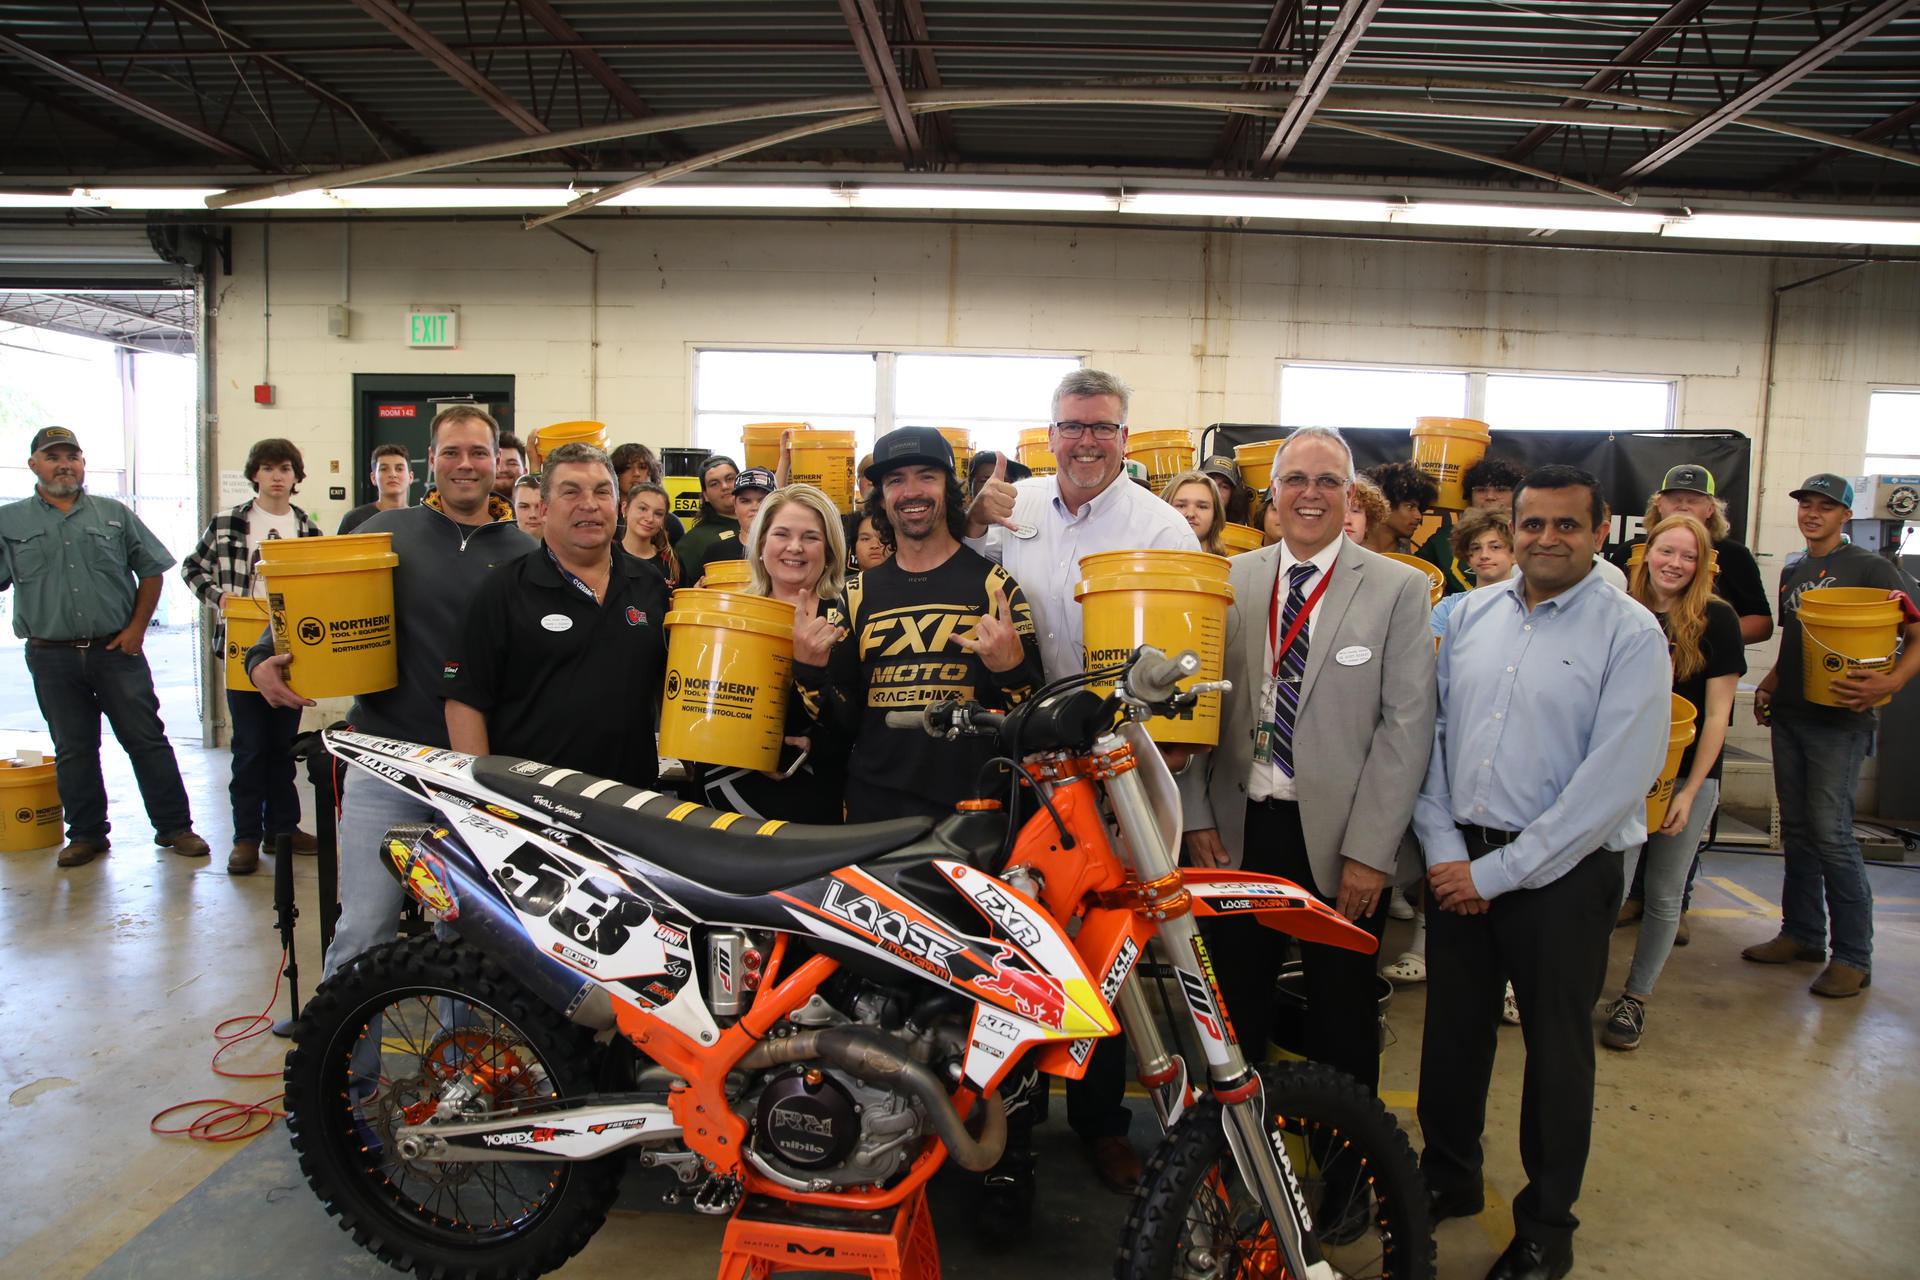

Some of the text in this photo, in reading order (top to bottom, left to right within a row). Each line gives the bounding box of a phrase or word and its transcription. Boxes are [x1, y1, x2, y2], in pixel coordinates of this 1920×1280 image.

[412, 316, 448, 342] EXIT
[1420, 462, 1459, 470] NORTHERN
[674, 500, 702, 510] ESA
[329, 615, 390, 632] NORTHERN
[358, 626, 390, 635] EQUIPMENT
[332, 640, 391, 653] NORTHERNTOOL.COM
[1091, 649, 1140, 662] NORTH
[870, 663, 968, 684] MOTO
[684, 678, 756, 696] NORTHERN
[709, 692, 754, 703] EQUIPMENT
[878, 690, 916, 702] RACE
[682, 705, 752, 719] NORTHERNTOOL.COM
[354, 754, 407, 781] MAXXIS
[532, 795, 554, 810] THRILL
[460, 816, 509, 838] RZR
[820, 880, 969, 969] LOOSE
[975, 884, 1041, 948] FXR
[656, 926, 684, 946] UNI
[562, 948, 597, 969] enjoy
[1178, 968, 1222, 1041] WP
[977, 1015, 1020, 1040] KTM
[607, 1119, 644, 1129] FASTWAY
[780, 1140, 824, 1153] nihilo
[1272, 1130, 1312, 1232] MAXXIS
